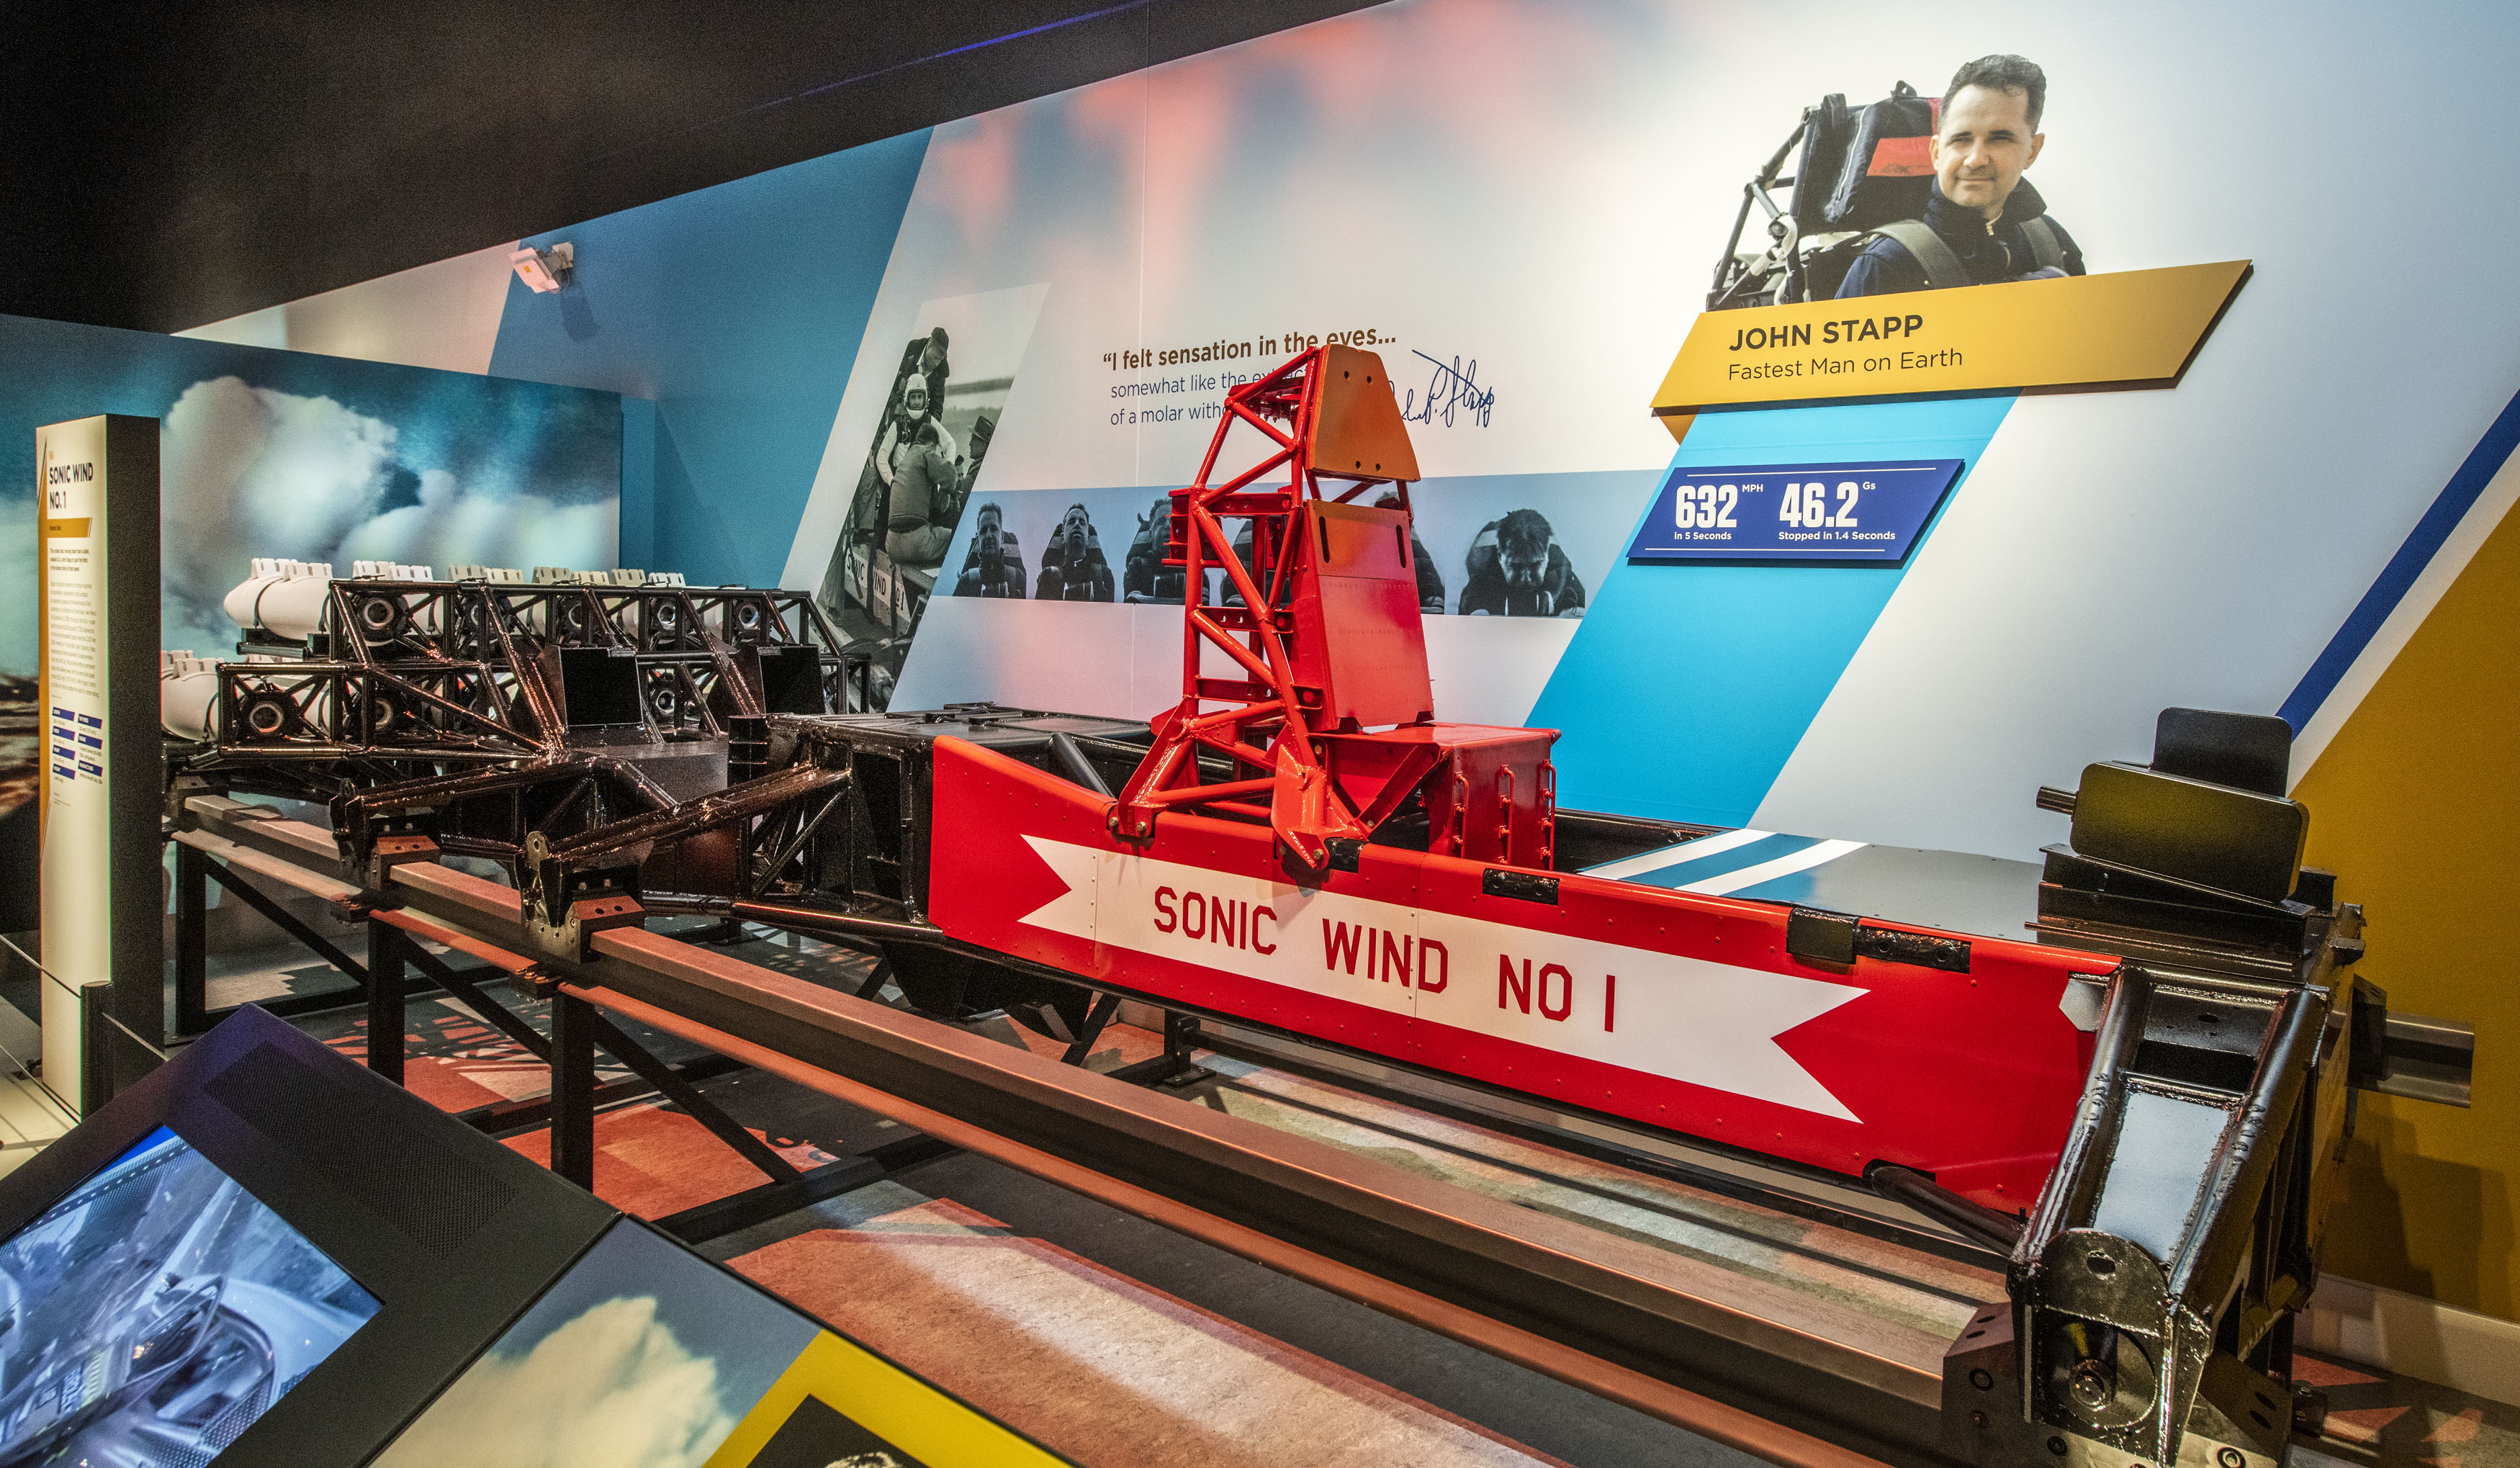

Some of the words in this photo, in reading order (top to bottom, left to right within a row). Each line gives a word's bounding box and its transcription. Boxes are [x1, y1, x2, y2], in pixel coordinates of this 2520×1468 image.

[1729, 323, 1812, 351] JOHN
[1822, 314, 1923, 344] STAPP
[1123, 348, 1152, 369] felt
[1158, 339, 1251, 366] sensation
[1259, 335, 1277, 356] in
[1284, 331, 1318, 354] the
[1729, 359, 1802, 381] Fastest
[1811, 357, 1855, 375] Man
[1863, 356, 1891, 372] on
[1901, 348, 1963, 370] Earth
[1111, 377, 1185, 398] somewhat
[1191, 374, 1216, 392] like
[1221, 371, 1246, 389] the
[1111, 408, 1125, 425] of
[1129, 412, 1136, 424] a
[1141, 405, 1183, 423] molar
[49, 464, 71, 485] SONIC
[73, 461, 94, 483] WIND
[50, 491, 62, 509] NO.
[63, 490, 66, 508] 1
[1675, 484, 1739, 528] 632
[1742, 484, 1763, 493] MPH
[1779, 481, 1859, 528] 46.2
[1862, 481, 1876, 490] Gs
[1674, 531, 1683, 540] in
[1685, 531, 1691, 540] 5
[1693, 531, 1732, 541] Seconds
[1778, 531, 1820, 541] Stopped
[1823, 531, 1832, 540] in
[1835, 531, 1849, 540] 1.4
[1852, 531, 1896, 540] Seconds
[847, 554, 865, 581] SNIC
[1153, 886, 1277, 955] SONIC
[1322, 917, 1448, 994] WIND
[1498, 953, 1572, 1022] NO
